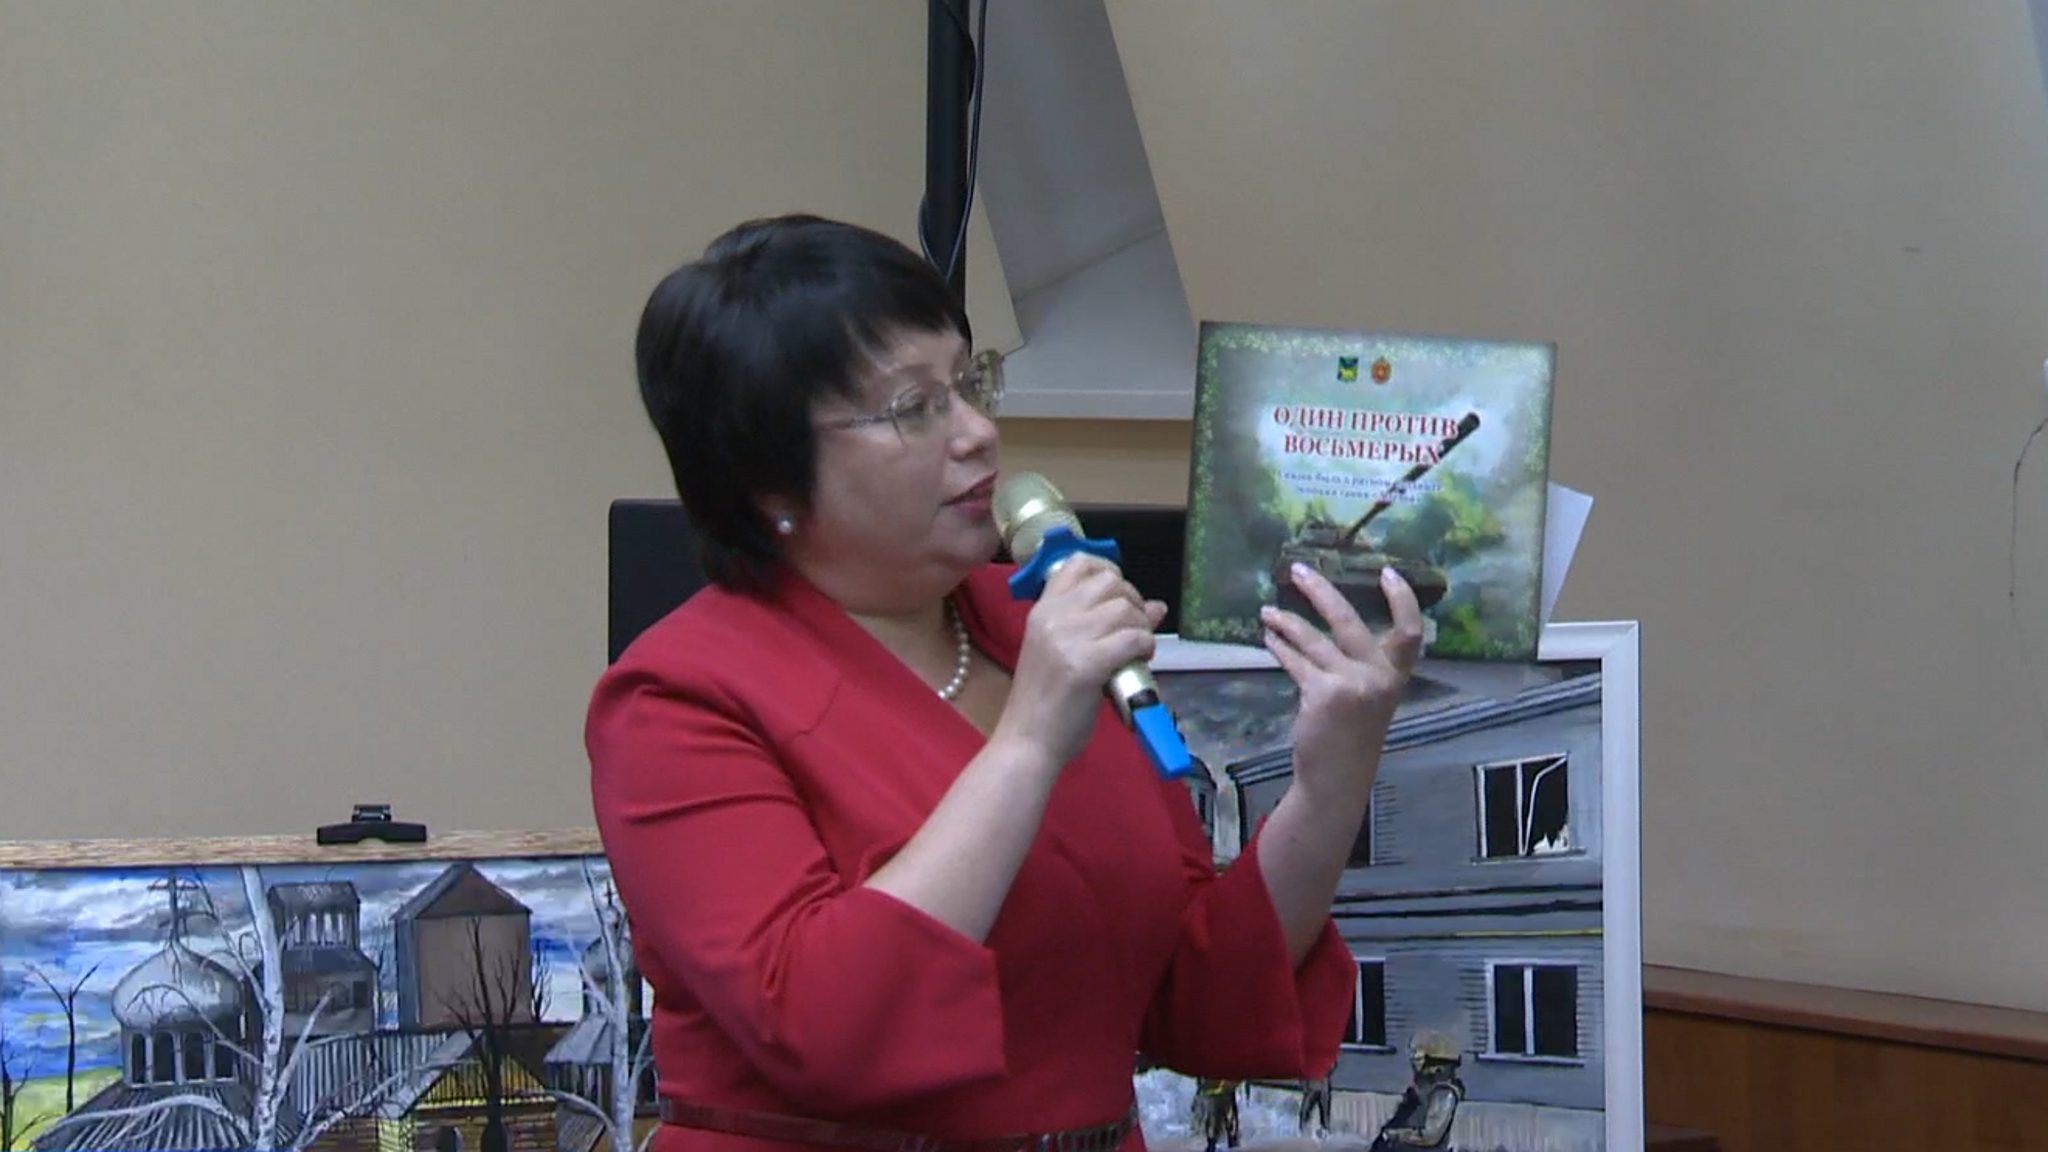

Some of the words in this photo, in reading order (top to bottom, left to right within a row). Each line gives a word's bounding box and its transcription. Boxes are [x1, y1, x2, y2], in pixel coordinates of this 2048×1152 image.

[1274, 406, 1343, 430] ОДИН
[1351, 411, 1457, 437] ПРОТИВ
[1284, 434, 1440, 464] ВОСЬМЕРЫХ
